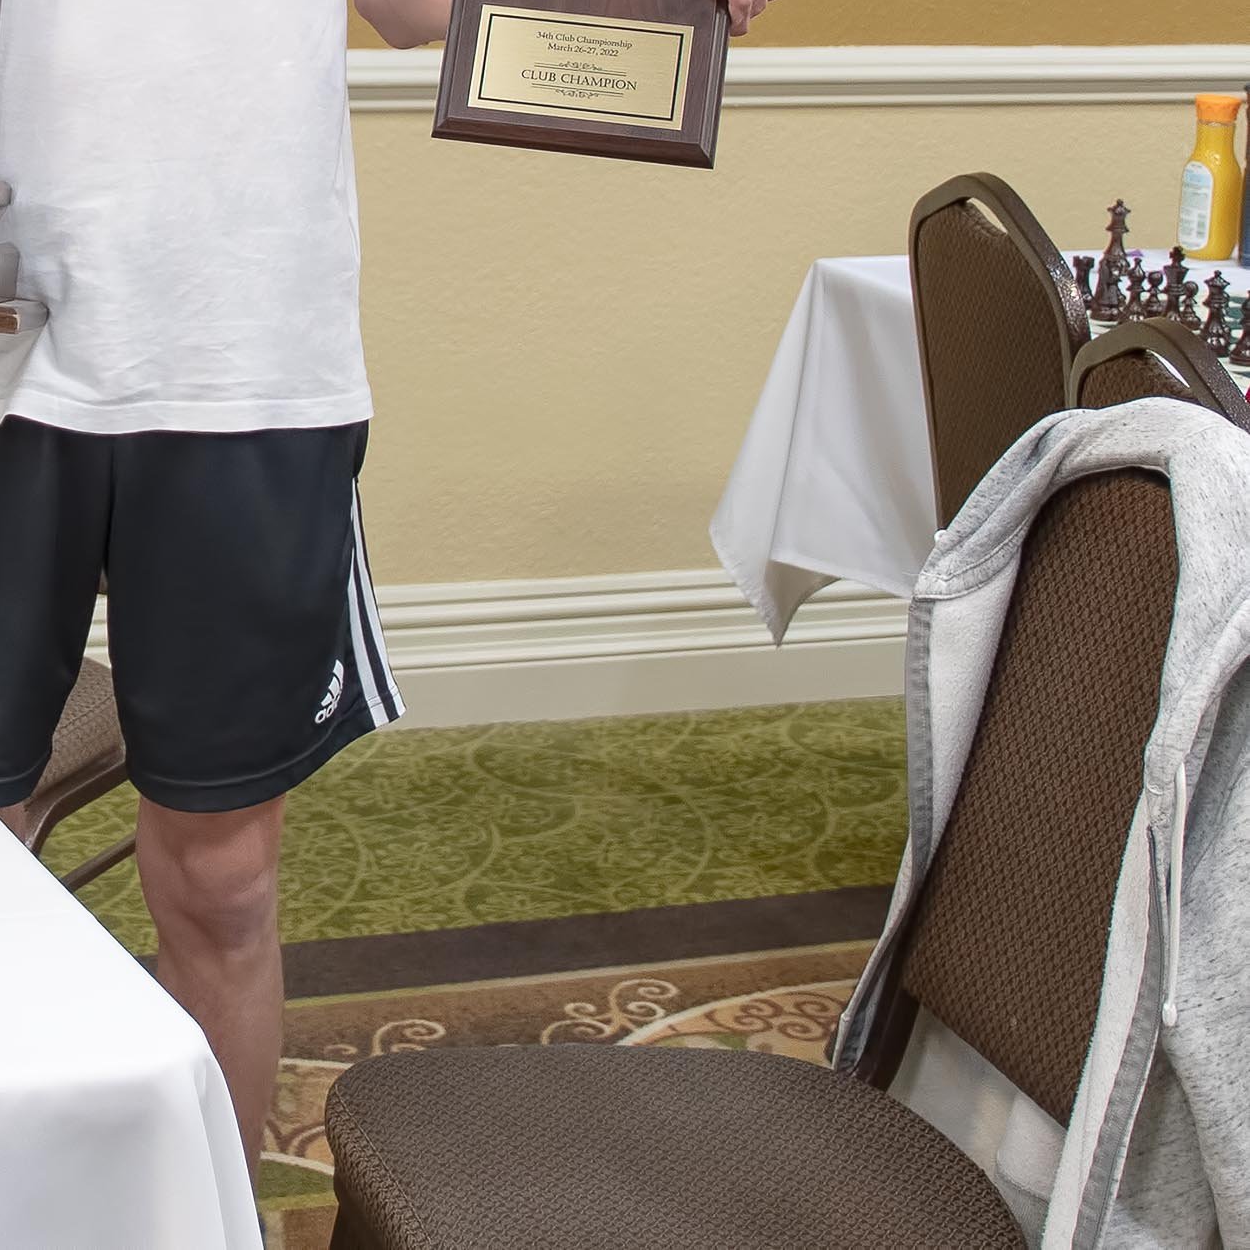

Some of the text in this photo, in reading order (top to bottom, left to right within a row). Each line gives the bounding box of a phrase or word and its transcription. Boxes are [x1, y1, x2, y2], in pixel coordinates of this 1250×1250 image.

[536, 31, 633, 50] 34th Club Championship
[547, 42, 573, 53] March
[599, 48, 619, 58] 2022
[521, 69, 638, 91] CLUB CHAMPION
